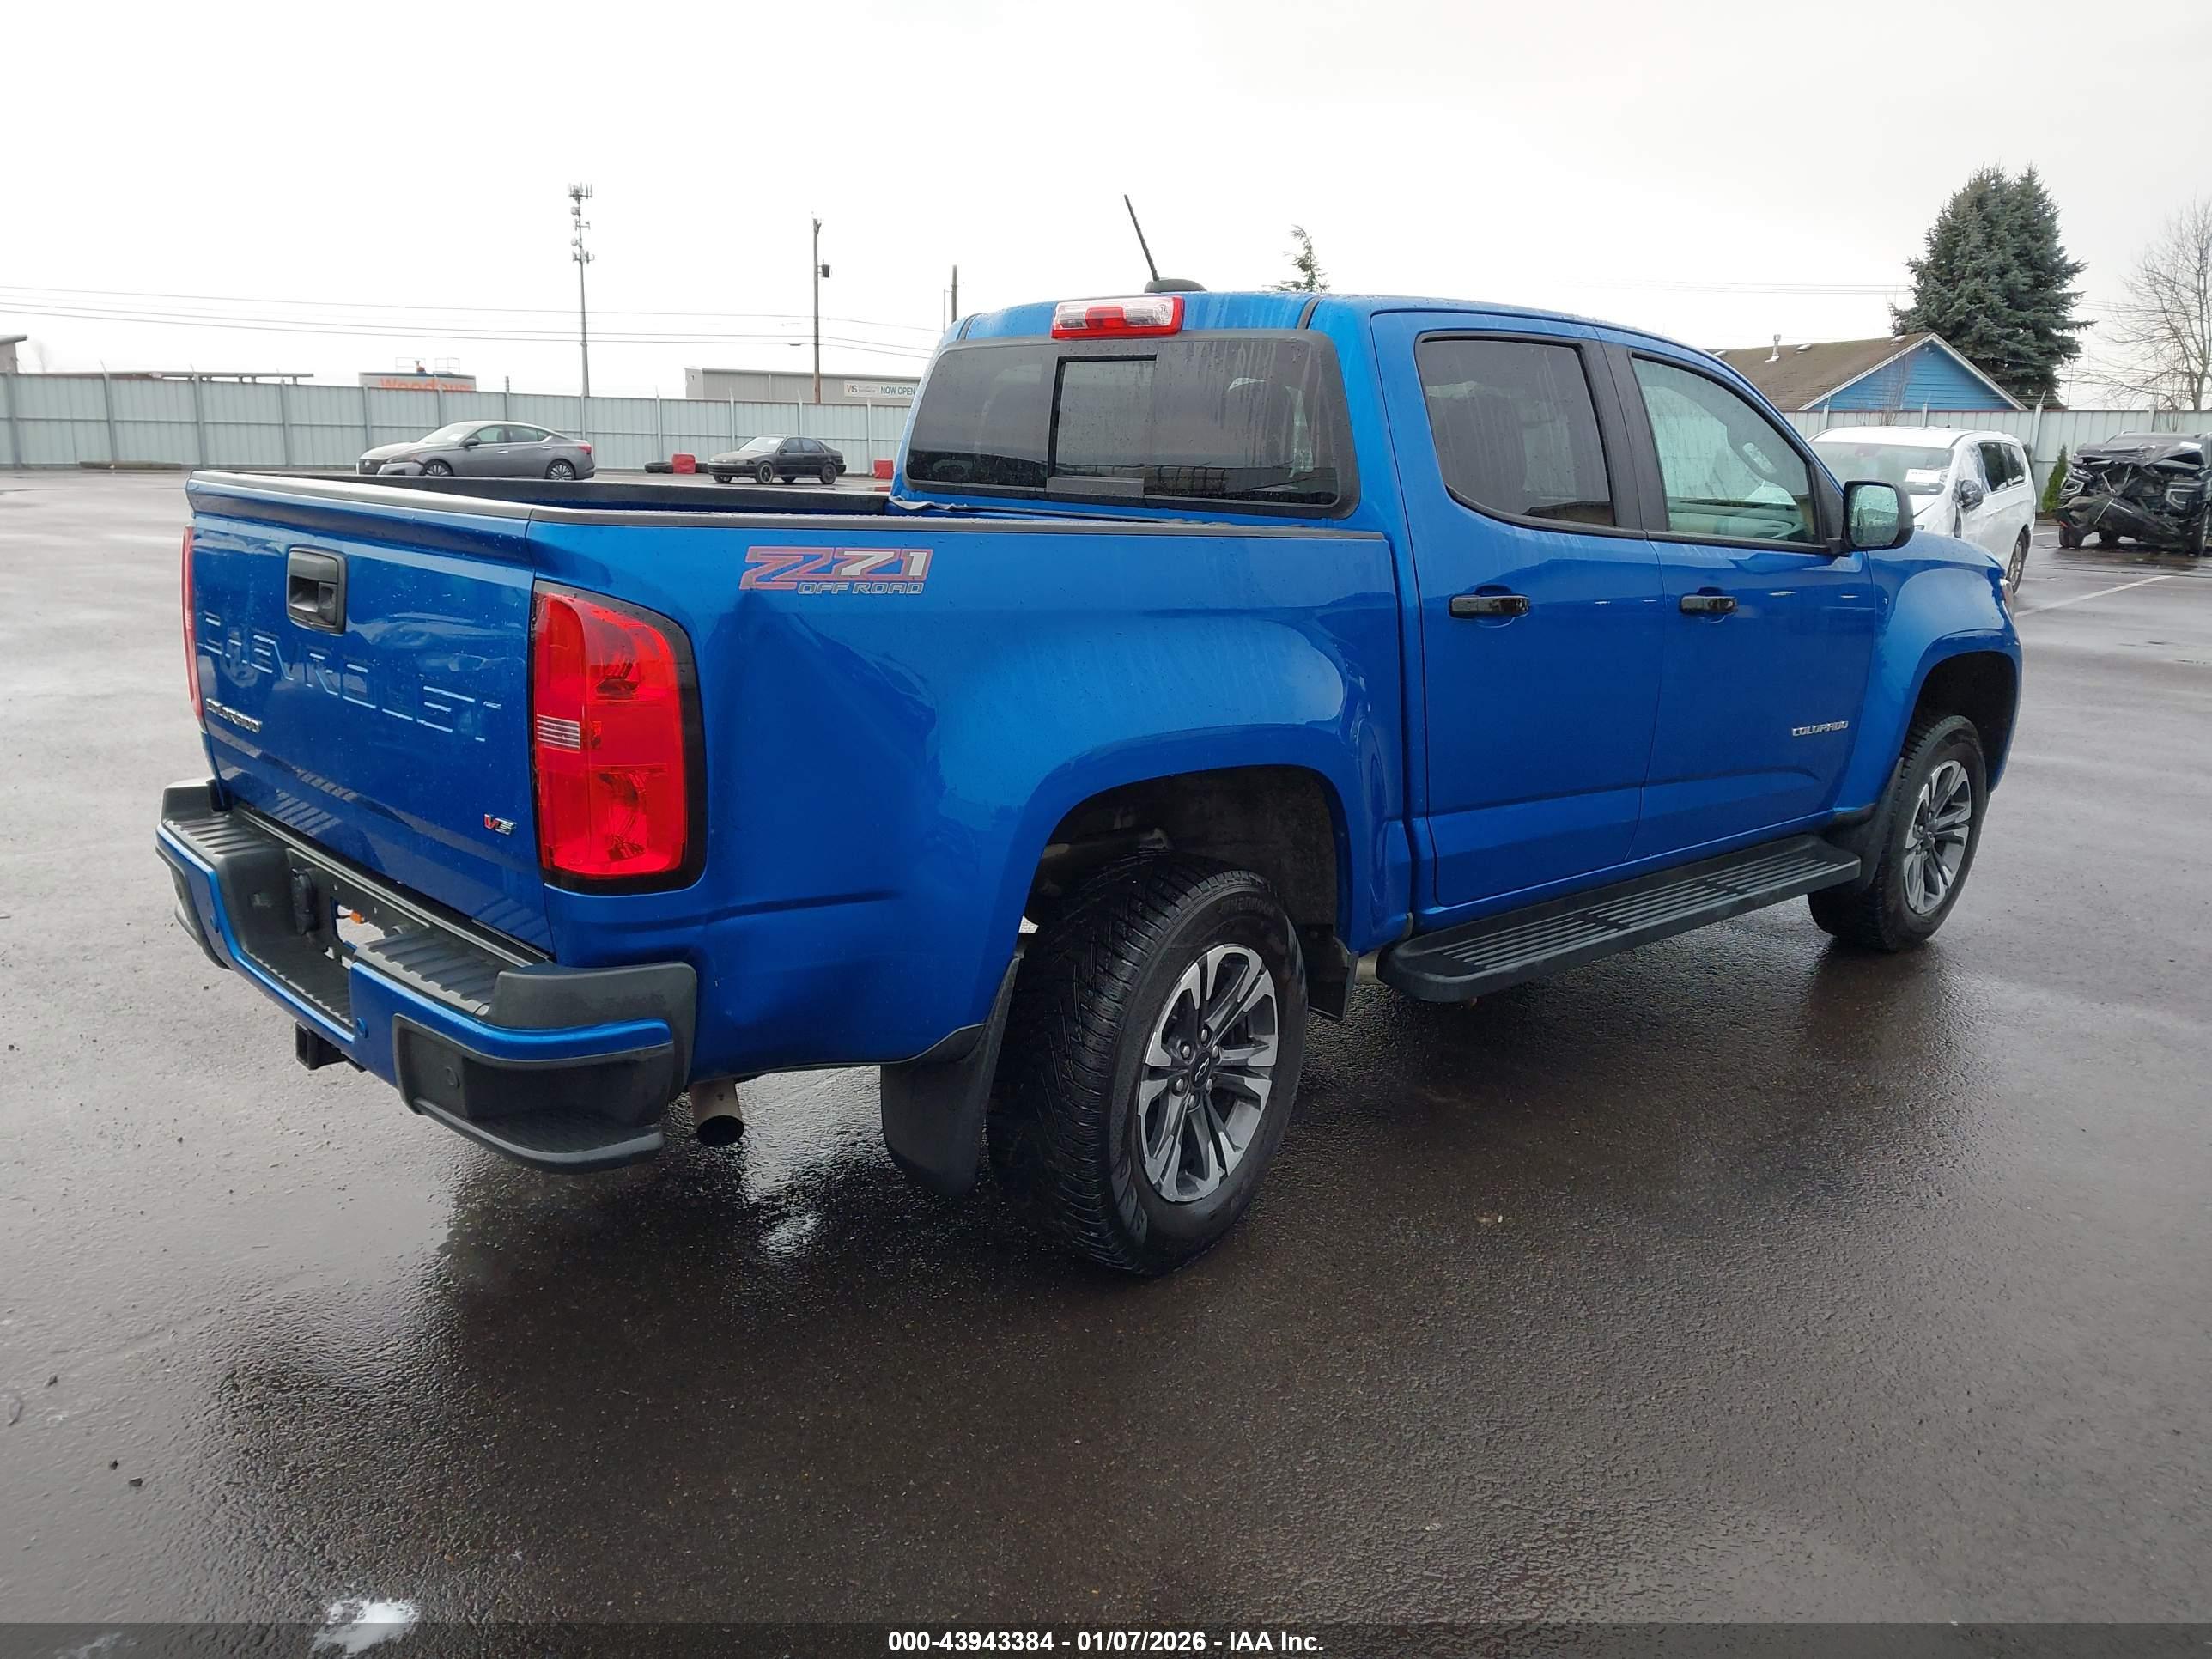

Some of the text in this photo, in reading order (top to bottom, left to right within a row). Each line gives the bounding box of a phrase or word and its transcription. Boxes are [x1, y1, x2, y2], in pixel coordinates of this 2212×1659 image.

[880, 386, 896, 395] NOW
[897, 386, 916, 396] OPEN
[739, 546, 933, 590] Z71
[797, 582, 924, 594] OFF ROAD
[1792, 720, 1849, 737] COLORADO
[483, 813, 517, 836] V6
